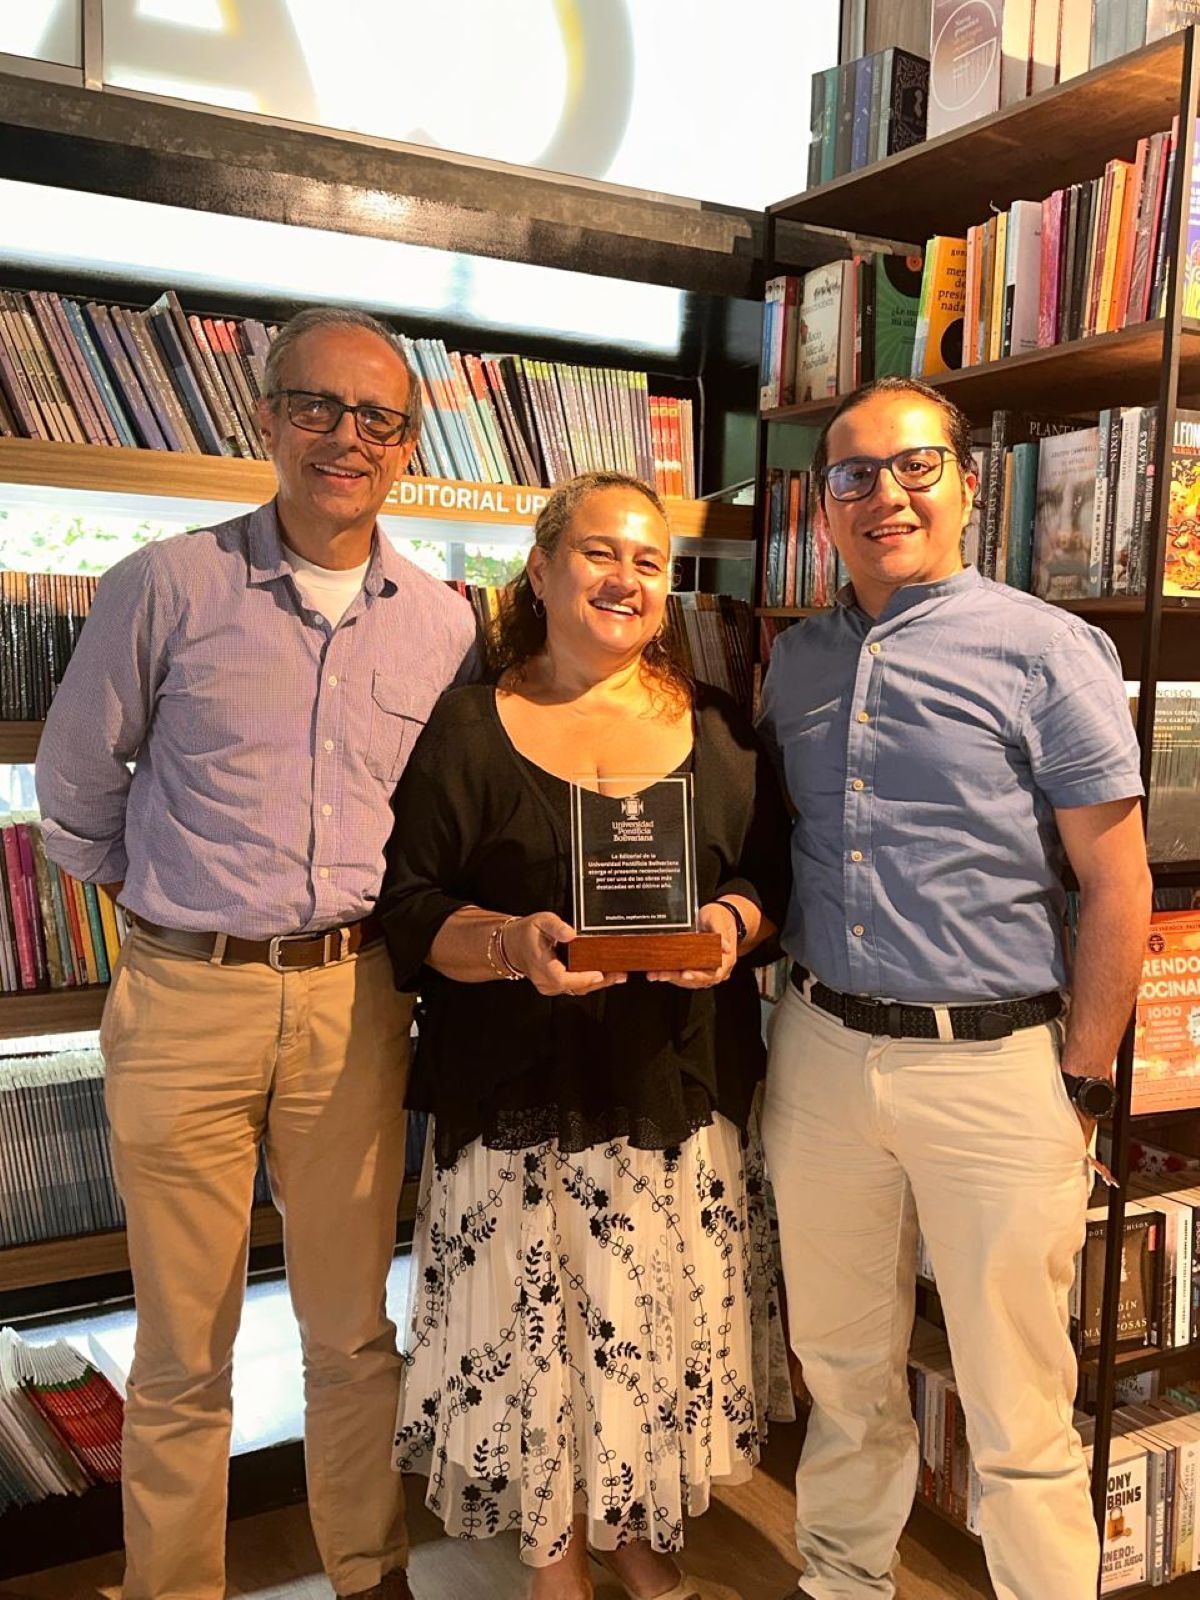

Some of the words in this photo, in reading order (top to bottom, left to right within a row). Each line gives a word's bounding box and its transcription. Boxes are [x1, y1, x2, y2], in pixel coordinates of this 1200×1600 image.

[938, 290, 966, 301] presi
[1137, 431, 1148, 475] MAYAS
[383, 480, 511, 513] EDITORIAL
[515, 491, 551, 515] UP
[1156, 688, 1192, 698] NCISCO
[1143, 955, 1200, 978] RENDO
[1139, 978, 1200, 1000] OCINA
[1107, 1471, 1132, 1493] ONY
[1105, 1485, 1142, 1511] BBINS
[1102, 1545, 1136, 1565] INERO:
